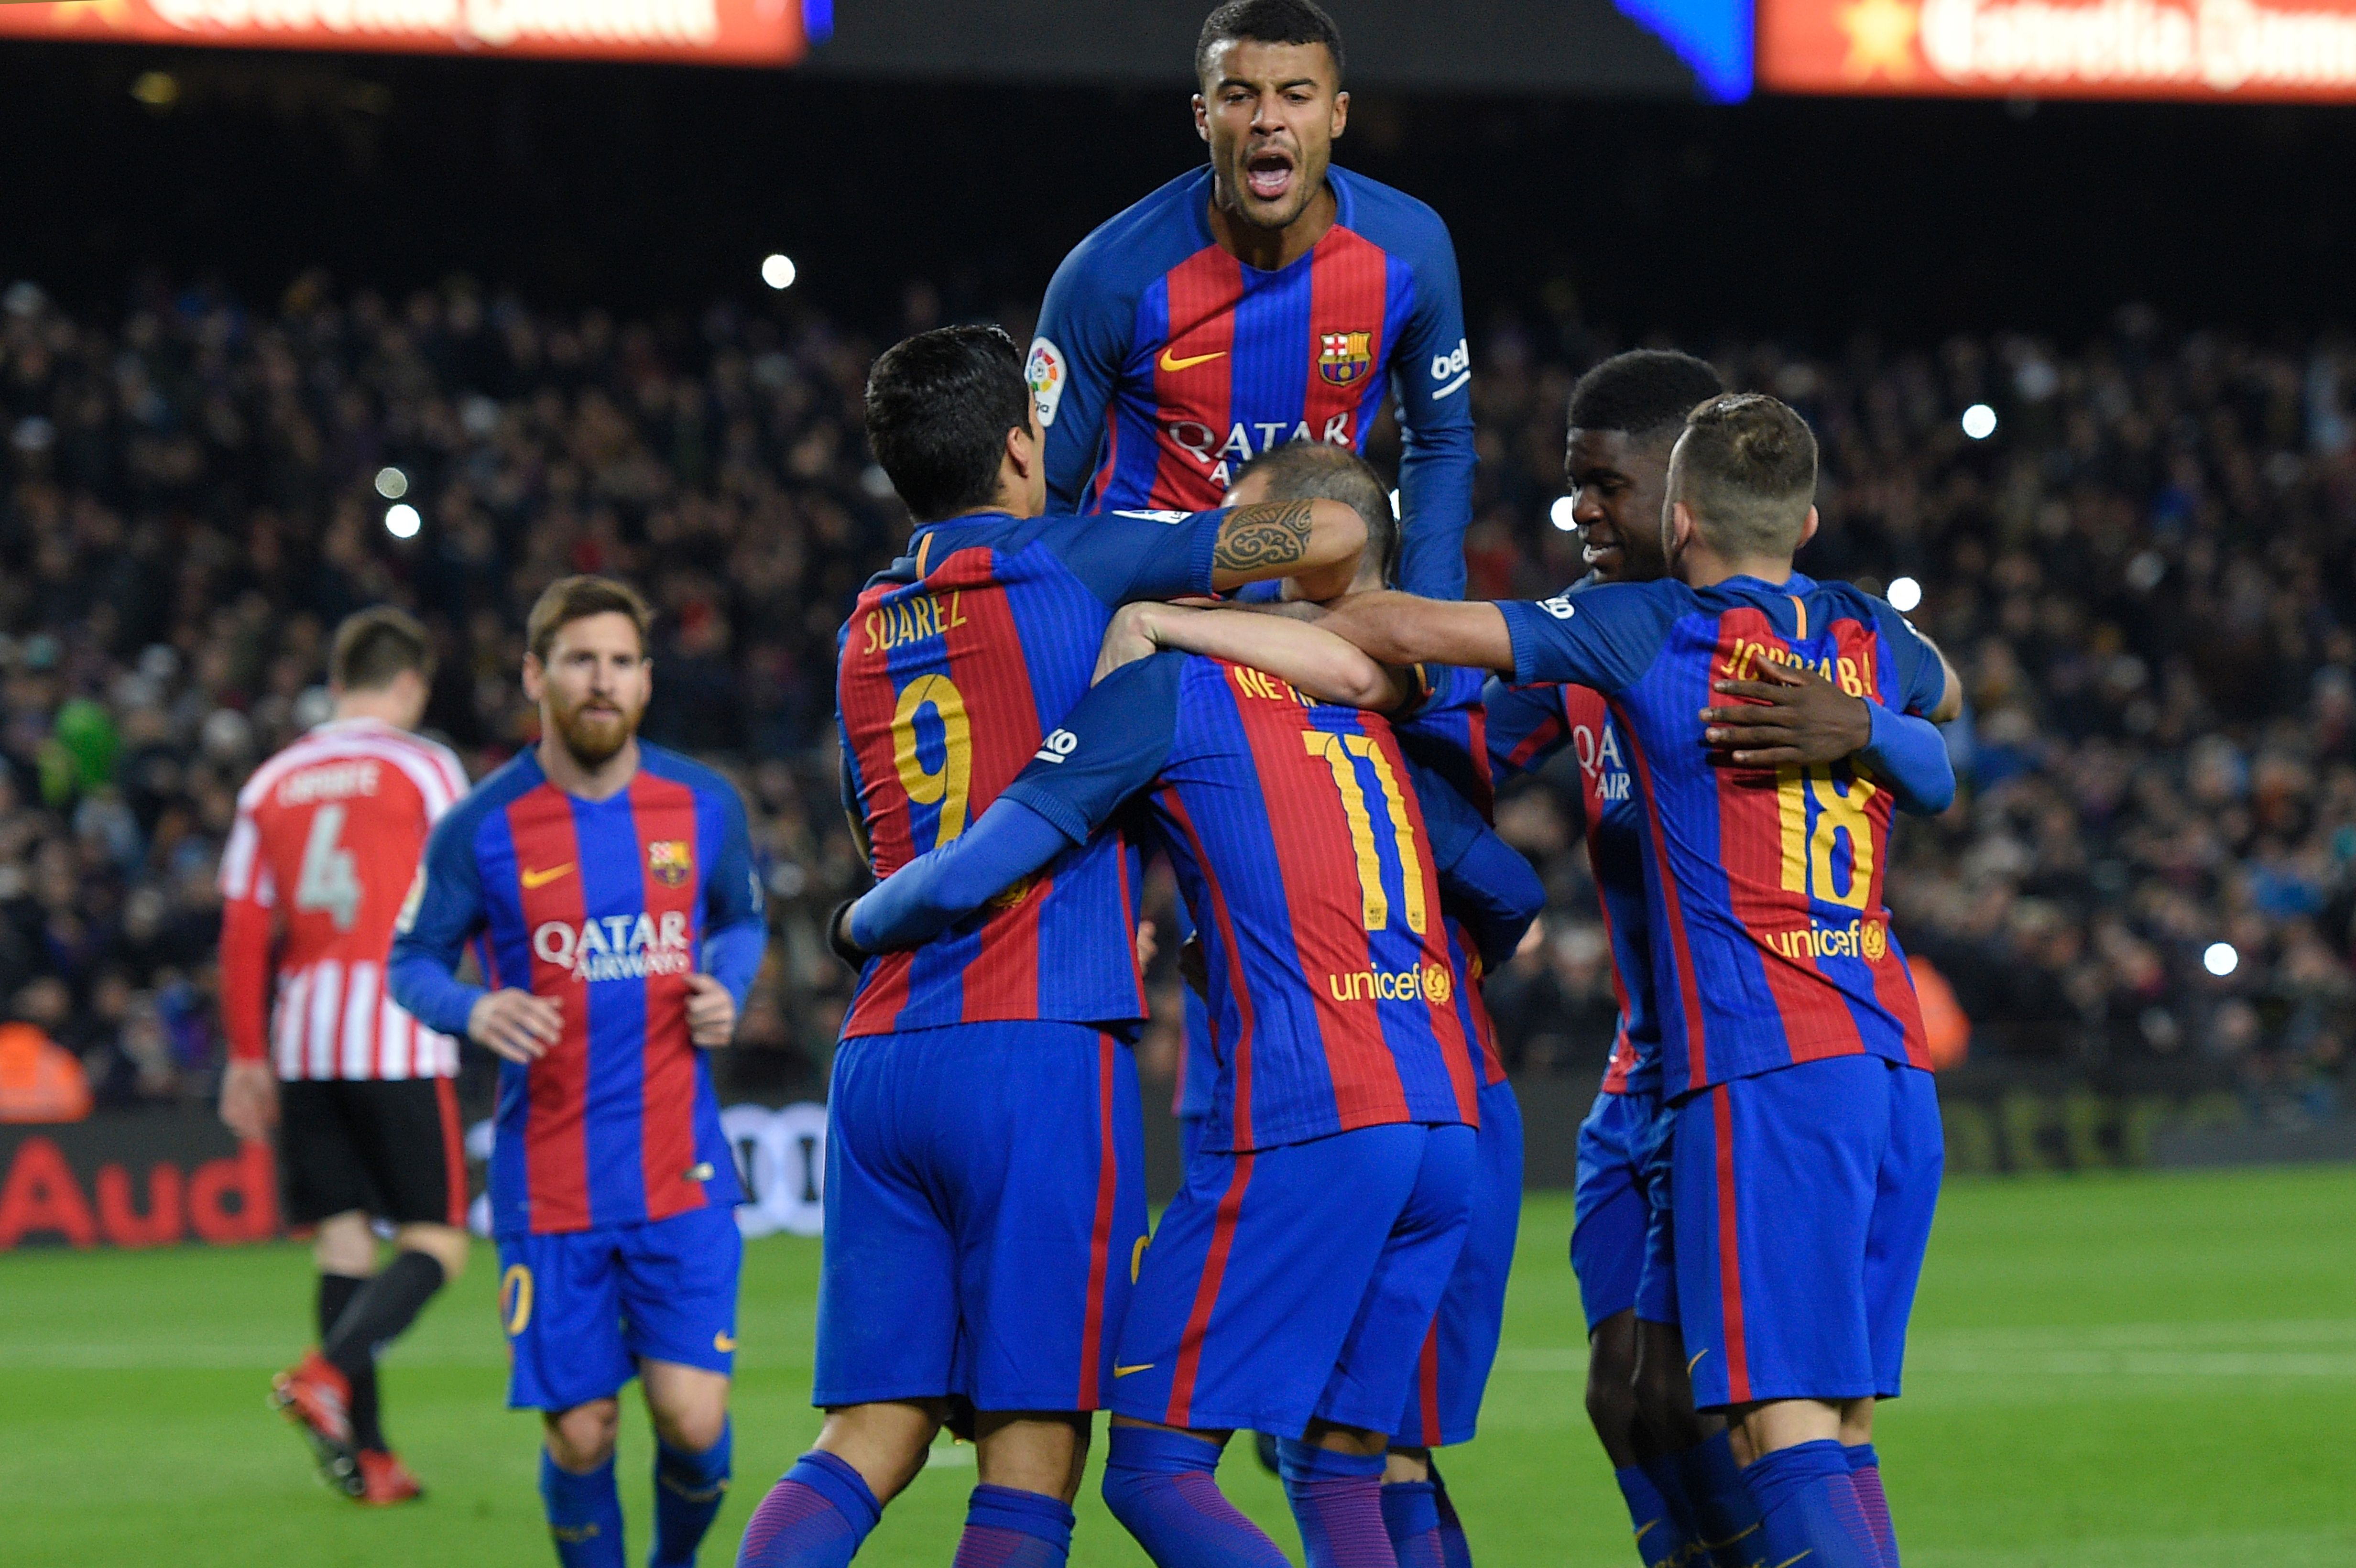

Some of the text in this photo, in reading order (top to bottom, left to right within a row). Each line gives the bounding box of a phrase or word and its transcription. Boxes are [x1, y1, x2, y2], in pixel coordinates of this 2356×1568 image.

[890, 674, 971, 849] 9
[292, 802, 365, 935] 4
[1301, 730, 1427, 936] 11
[1776, 759, 1875, 911] 18
[533, 910, 689, 969] QATAR
[1329, 962, 1423, 1001] unicef
[1765, 919, 1860, 958] unicef
[0, 1133, 277, 1250] Aud
